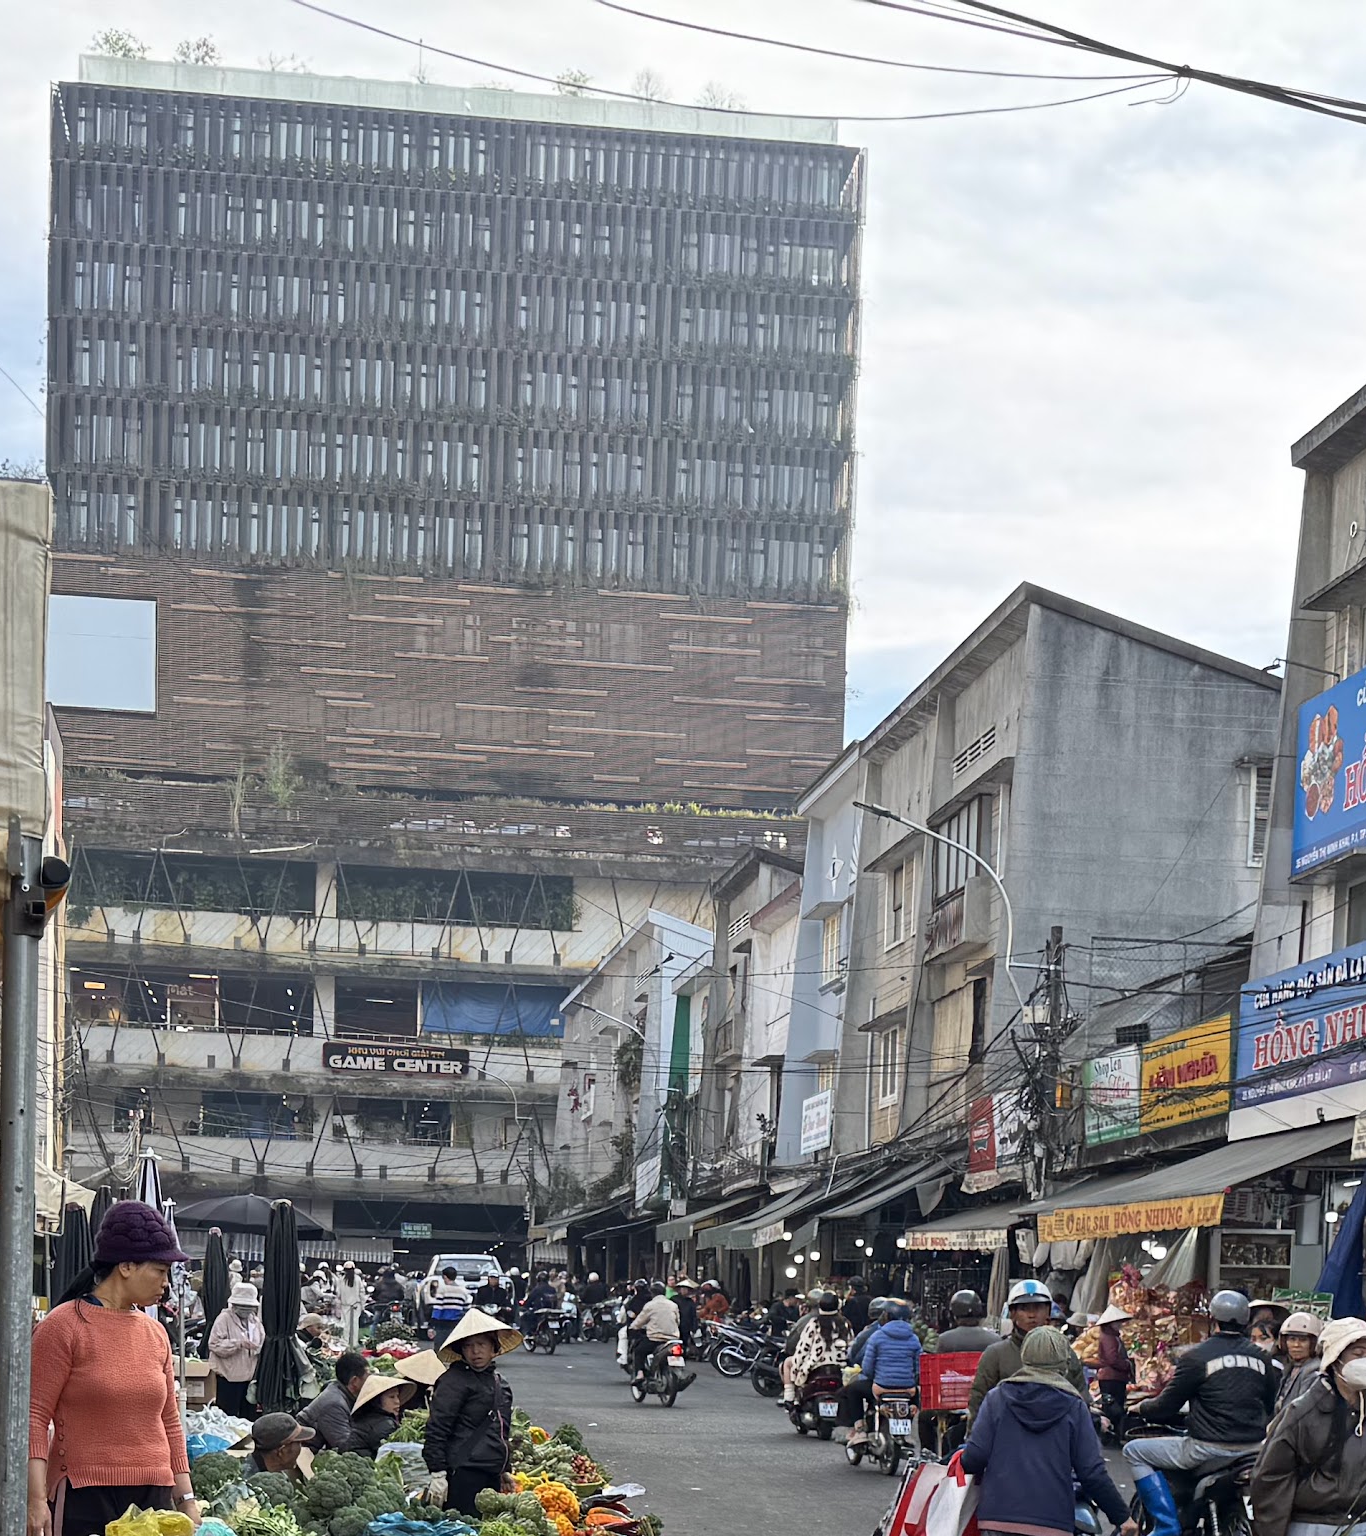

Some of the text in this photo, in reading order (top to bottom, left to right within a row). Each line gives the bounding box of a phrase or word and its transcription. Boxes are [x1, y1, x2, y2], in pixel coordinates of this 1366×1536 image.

[1253, 1008, 1319, 1071] HỒNG
[369, 1047, 385, 1056] VUI
[329, 1055, 463, 1075] GAME CENTER
[1114, 1205, 1142, 1229] HỒNG
[1145, 1206, 1183, 1227] NHUNG
